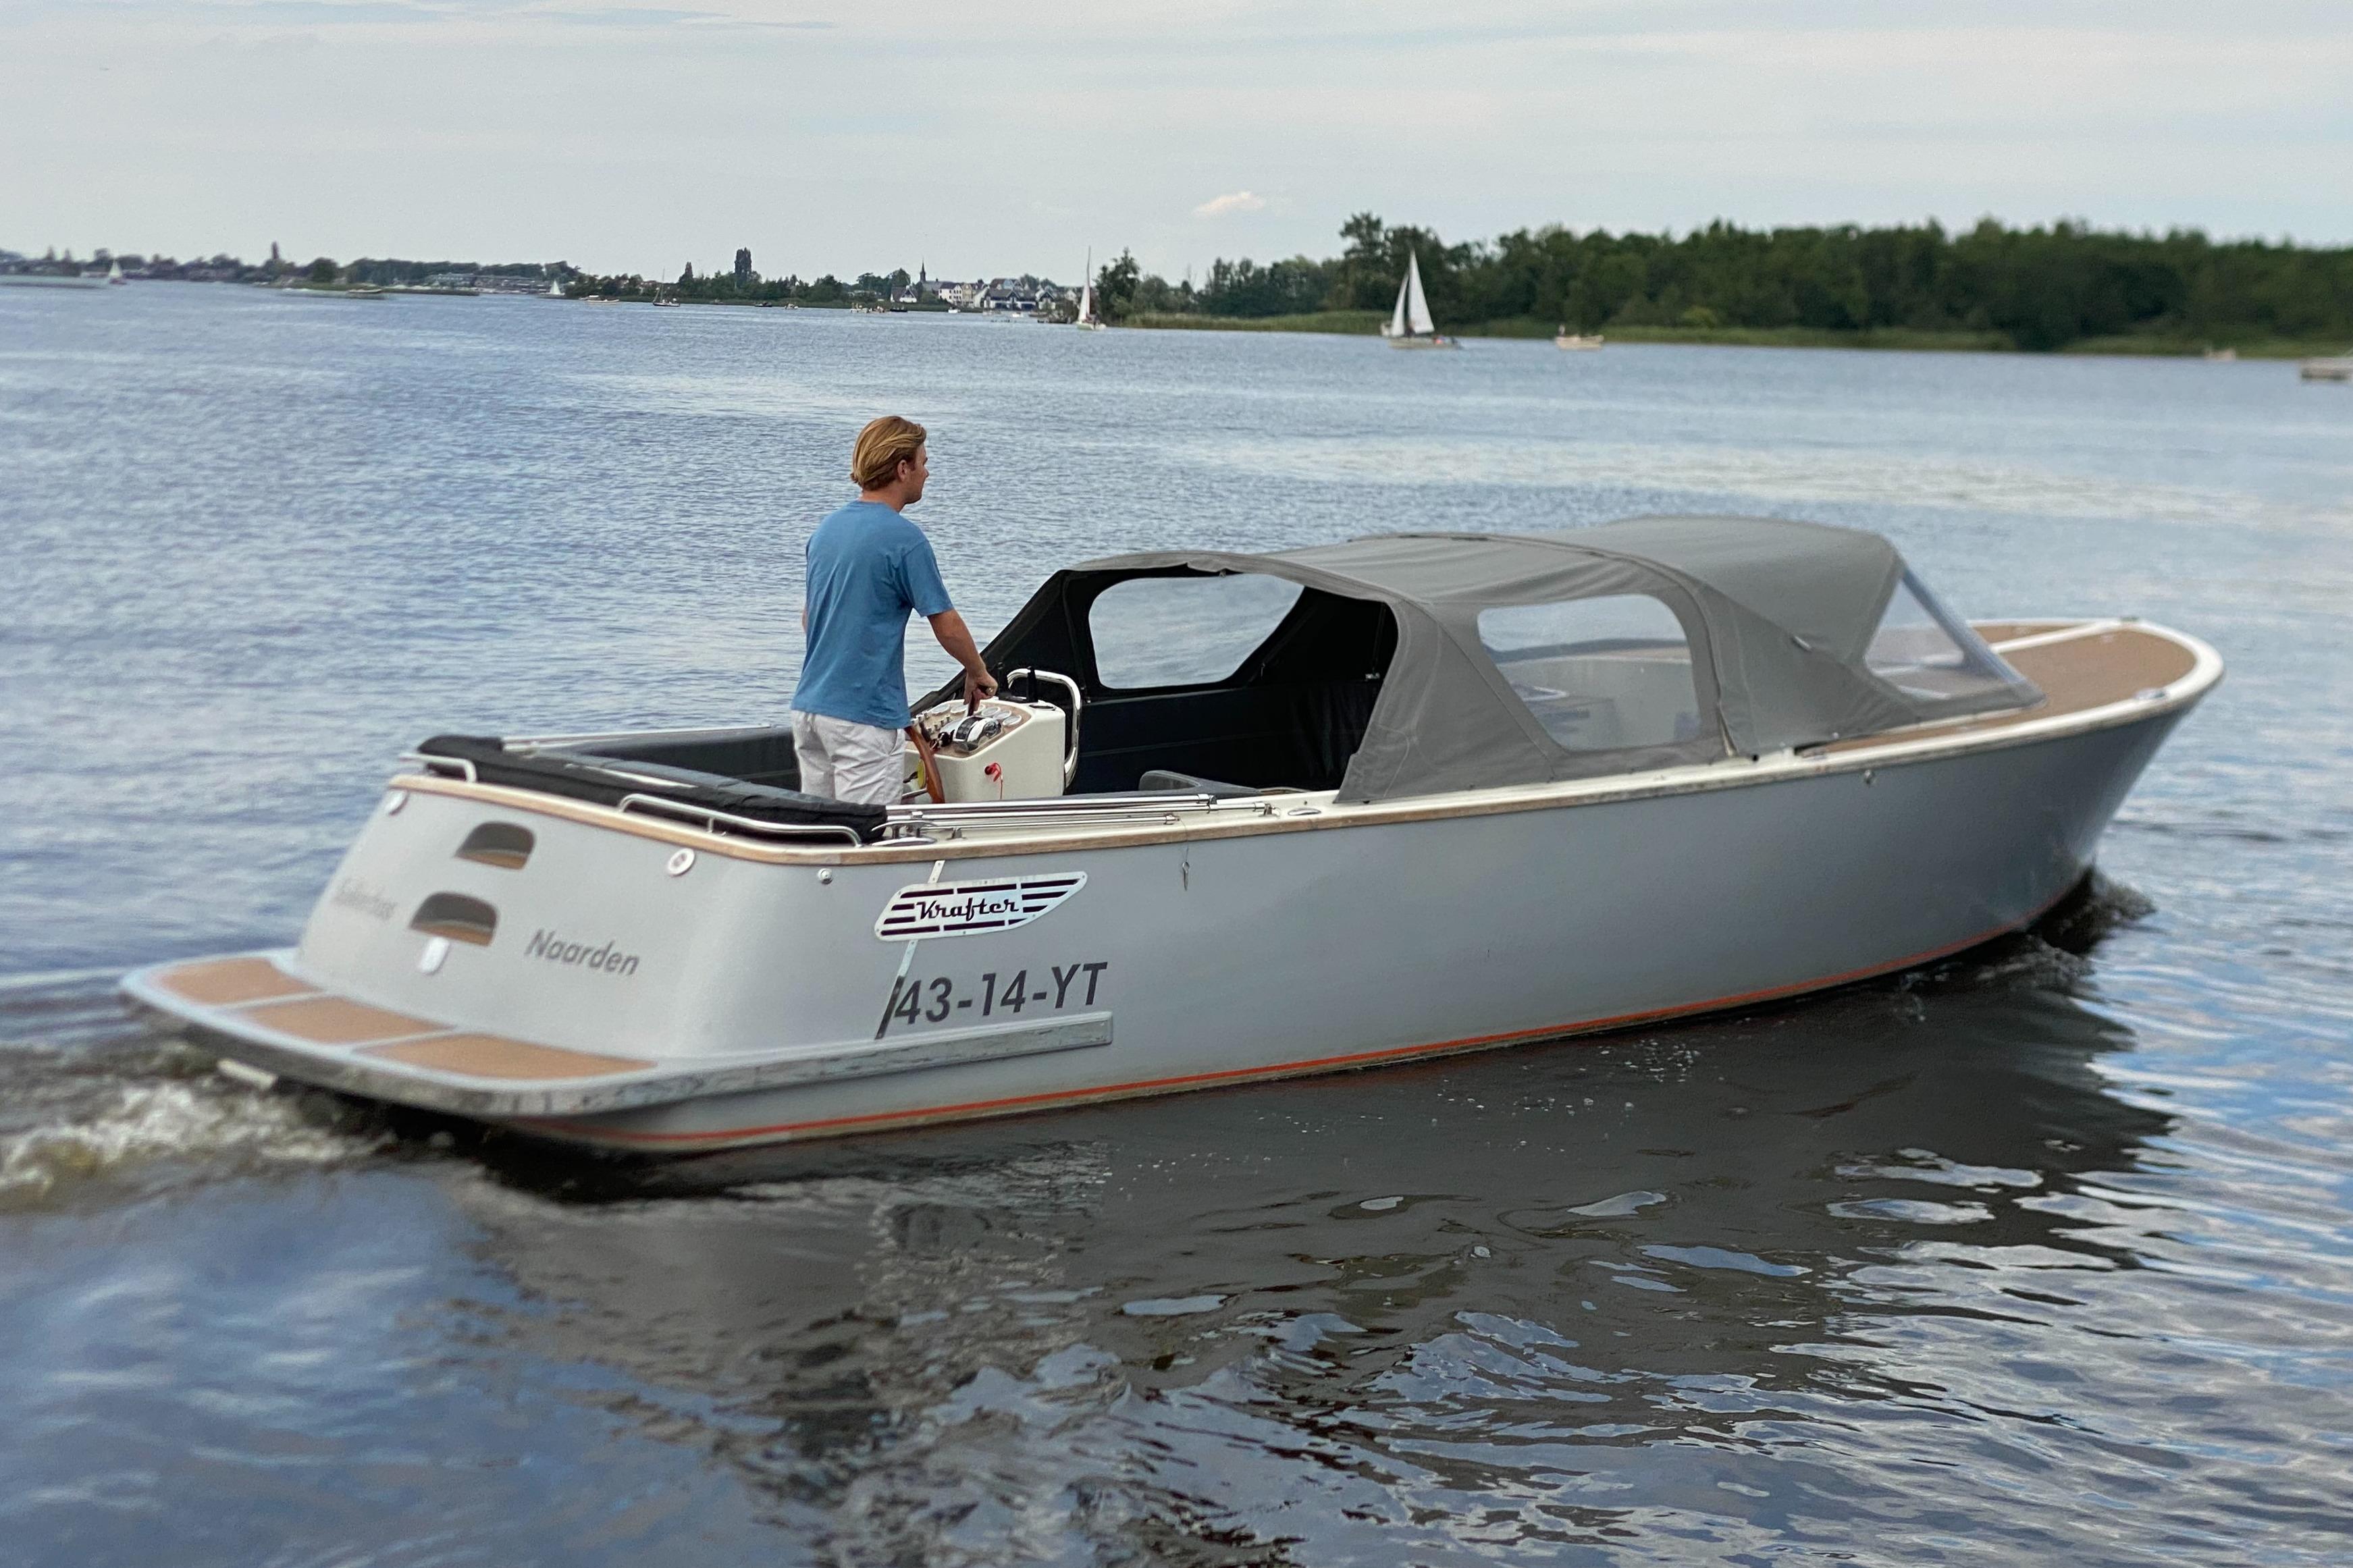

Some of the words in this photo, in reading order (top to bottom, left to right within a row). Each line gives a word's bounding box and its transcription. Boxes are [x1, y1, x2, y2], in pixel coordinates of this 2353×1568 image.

[916, 897, 1020, 921] Krafter
[524, 928, 640, 975] Naarden
[895, 961, 1108, 1025] 43-14-YT
